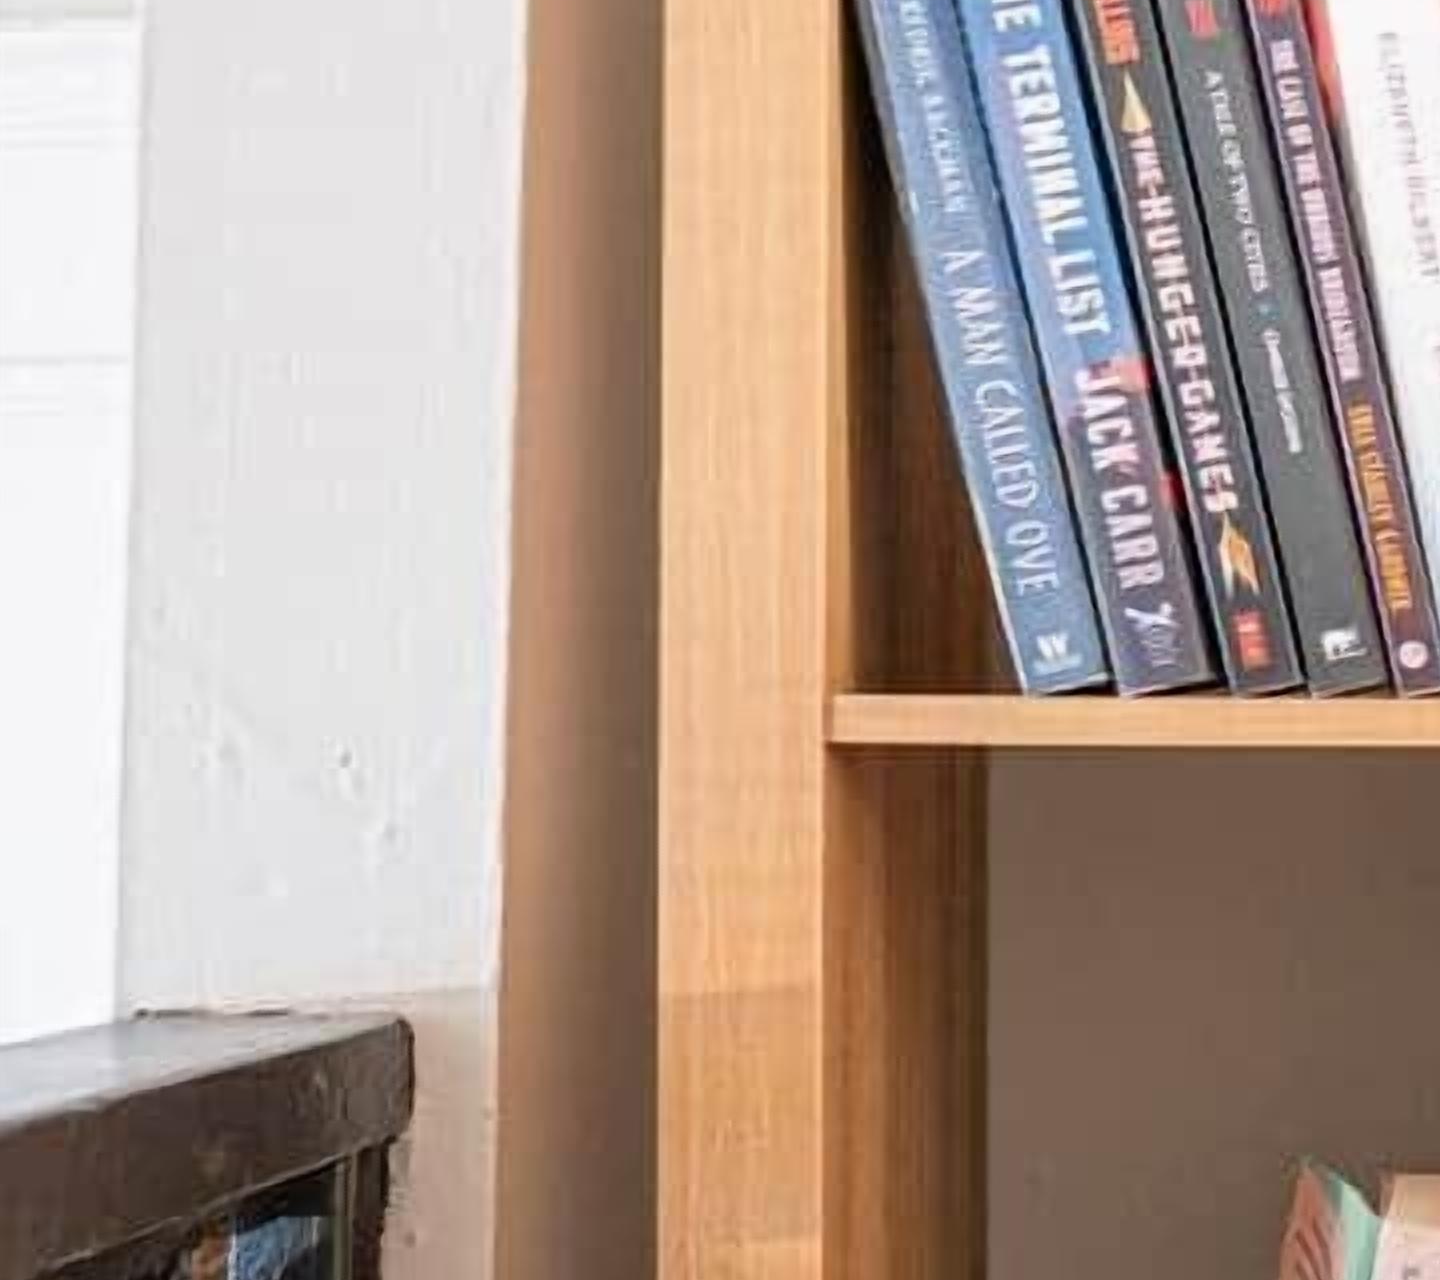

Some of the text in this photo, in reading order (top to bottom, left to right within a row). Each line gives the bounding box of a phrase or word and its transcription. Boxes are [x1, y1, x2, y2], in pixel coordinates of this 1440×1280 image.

[1000, 44, 1091, 245] TERMINAL
[1046, 248, 1111, 338] LIST
[1126, 134, 1240, 514] THE HUNGER GAMES
[939, 248, 1063, 596] A MAN CALLED OVE
[1070, 363, 1143, 480] JACK
[1097, 483, 1168, 590] CARR
